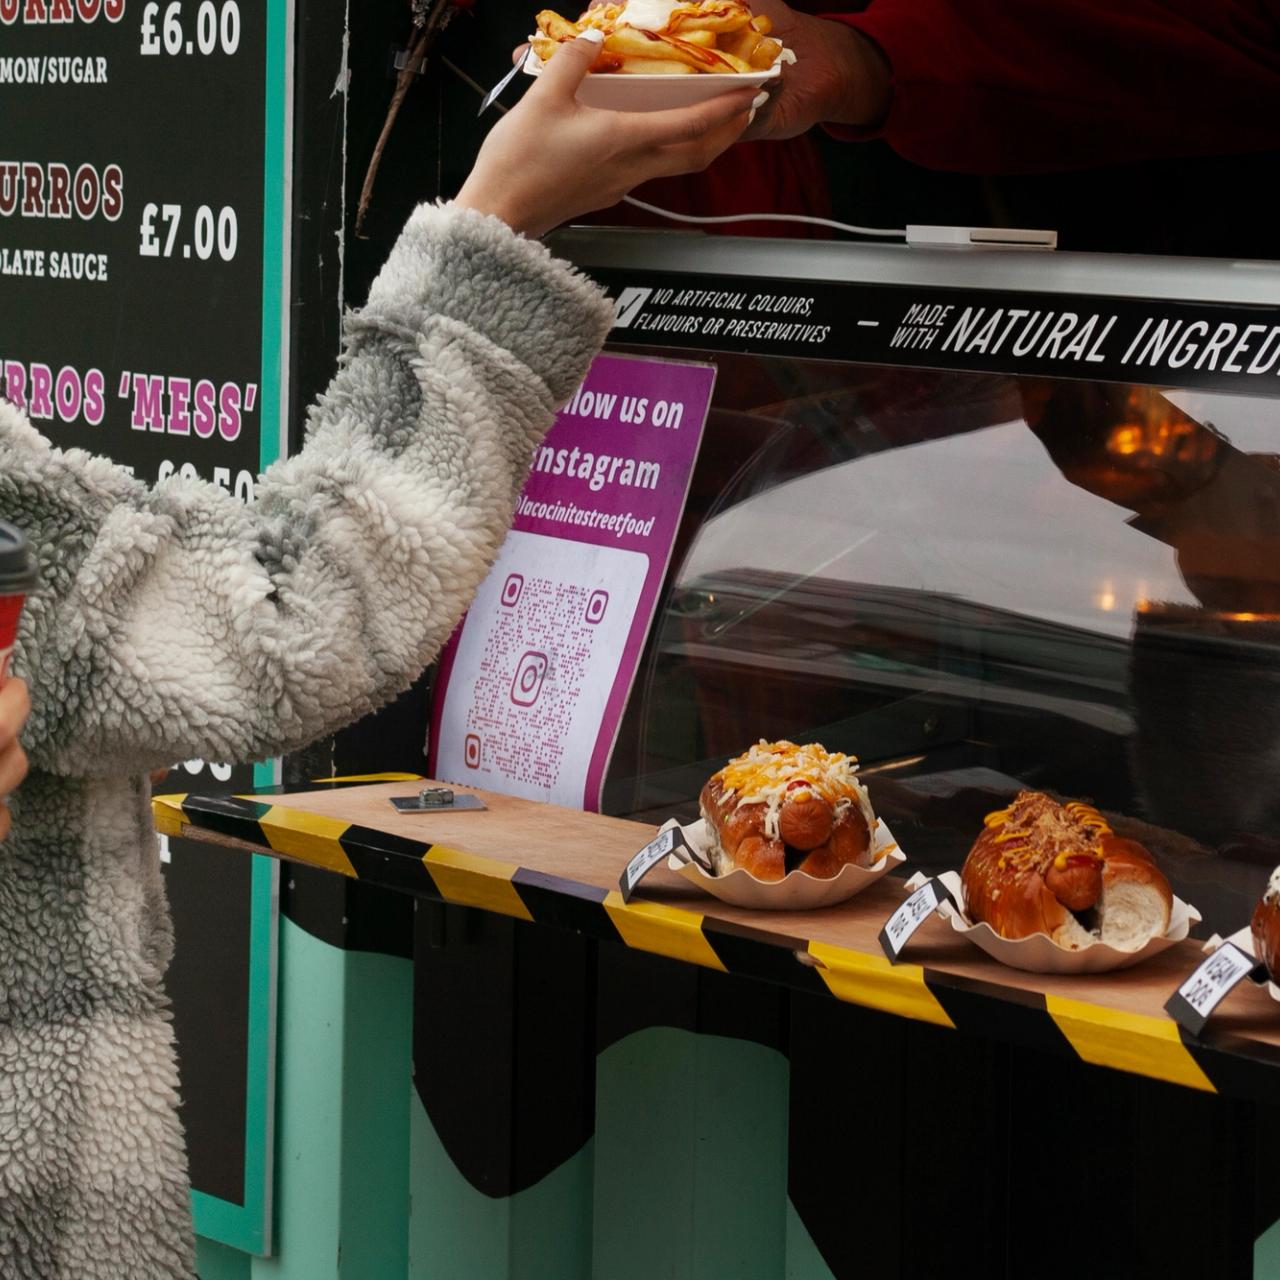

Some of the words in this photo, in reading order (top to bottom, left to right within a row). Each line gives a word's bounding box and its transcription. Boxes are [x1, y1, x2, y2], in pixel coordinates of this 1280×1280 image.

[140, 0, 241, 56] £6.00
[139, 202, 239, 261] £7.00
[49, 251, 109, 281] SAUCE
[650, 288, 674, 305] NO
[671, 289, 748, 310] ARTIFICIAL
[748, 294, 815, 317] COLOURS,
[901, 303, 955, 326] MADE
[633, 313, 703, 334] FLAVOURS
[701, 318, 725, 336] OR
[722, 320, 831, 343] PRESERVATIVES
[889, 326, 940, 350] WITH
[940, 306, 1118, 363] NATURAL
[118, 371, 257, 442] 'MESS'
[620, 395, 649, 425] us
[651, 400, 684, 429] on
[529, 445, 661, 492] nstagram
